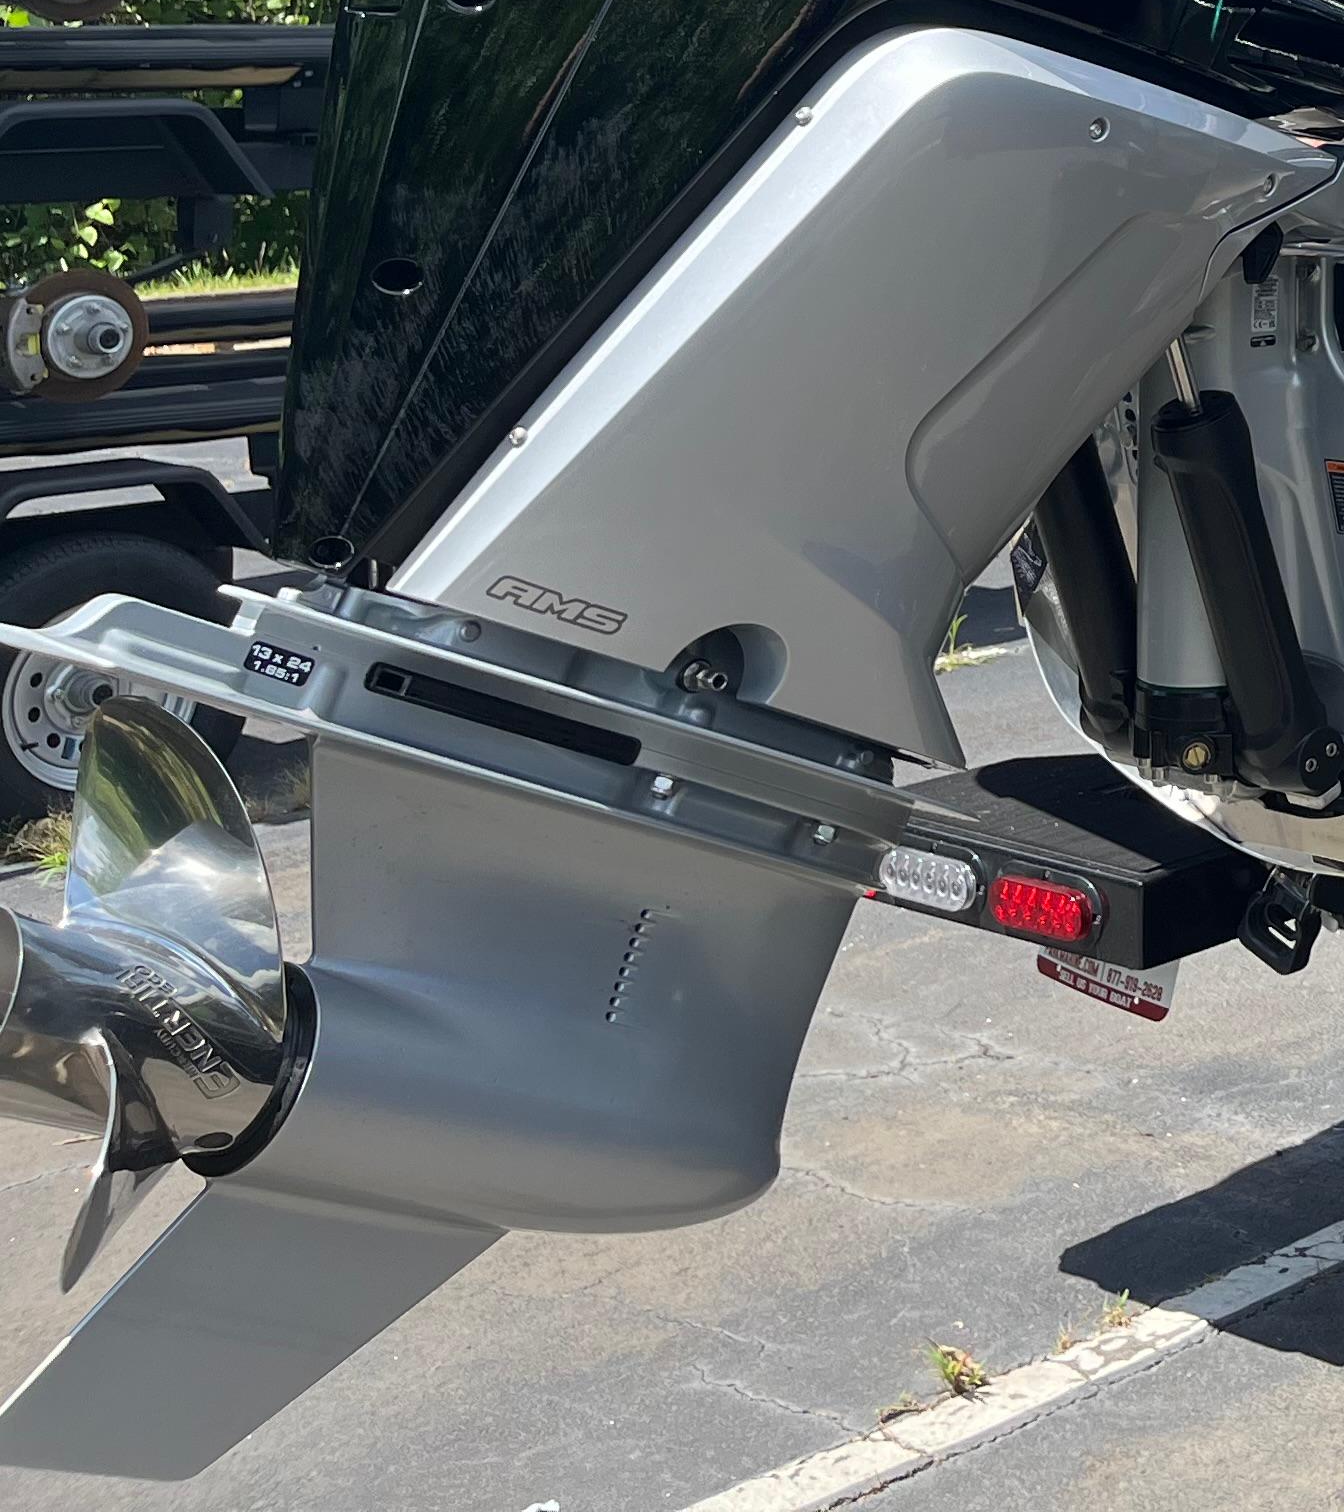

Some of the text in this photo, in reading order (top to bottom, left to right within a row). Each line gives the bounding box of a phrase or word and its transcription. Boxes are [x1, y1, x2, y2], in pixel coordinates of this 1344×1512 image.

[486, 575, 628, 635] AMS
[252, 644, 273, 660] 13
[286, 656, 312, 673] 24
